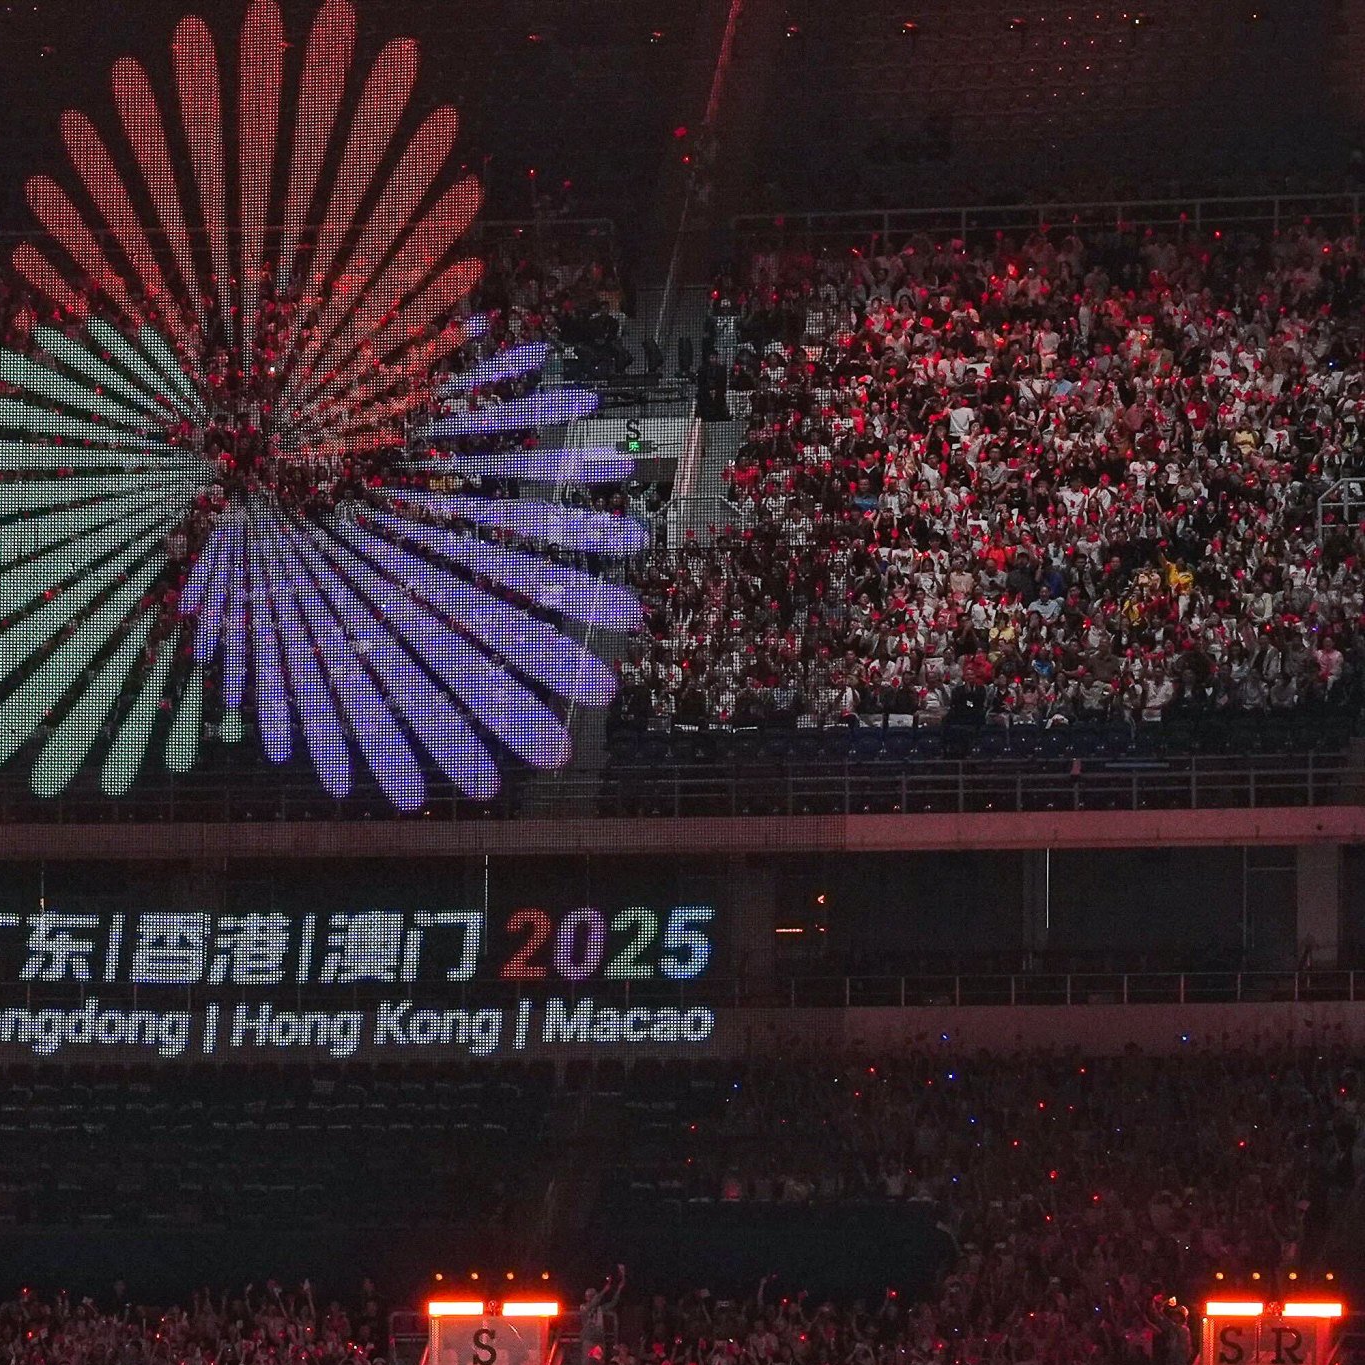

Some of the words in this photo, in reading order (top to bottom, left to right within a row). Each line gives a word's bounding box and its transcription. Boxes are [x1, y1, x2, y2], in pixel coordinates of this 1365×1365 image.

[501, 906, 715, 979] 2025
[230, 1003, 362, 1057] Hong
[373, 1000, 502, 1055] Kong
[542, 998, 715, 1043] Macao
[472, 1328, 497, 1365] S
[1220, 1326, 1243, 1364] S
[1271, 1327, 1304, 1364] R
